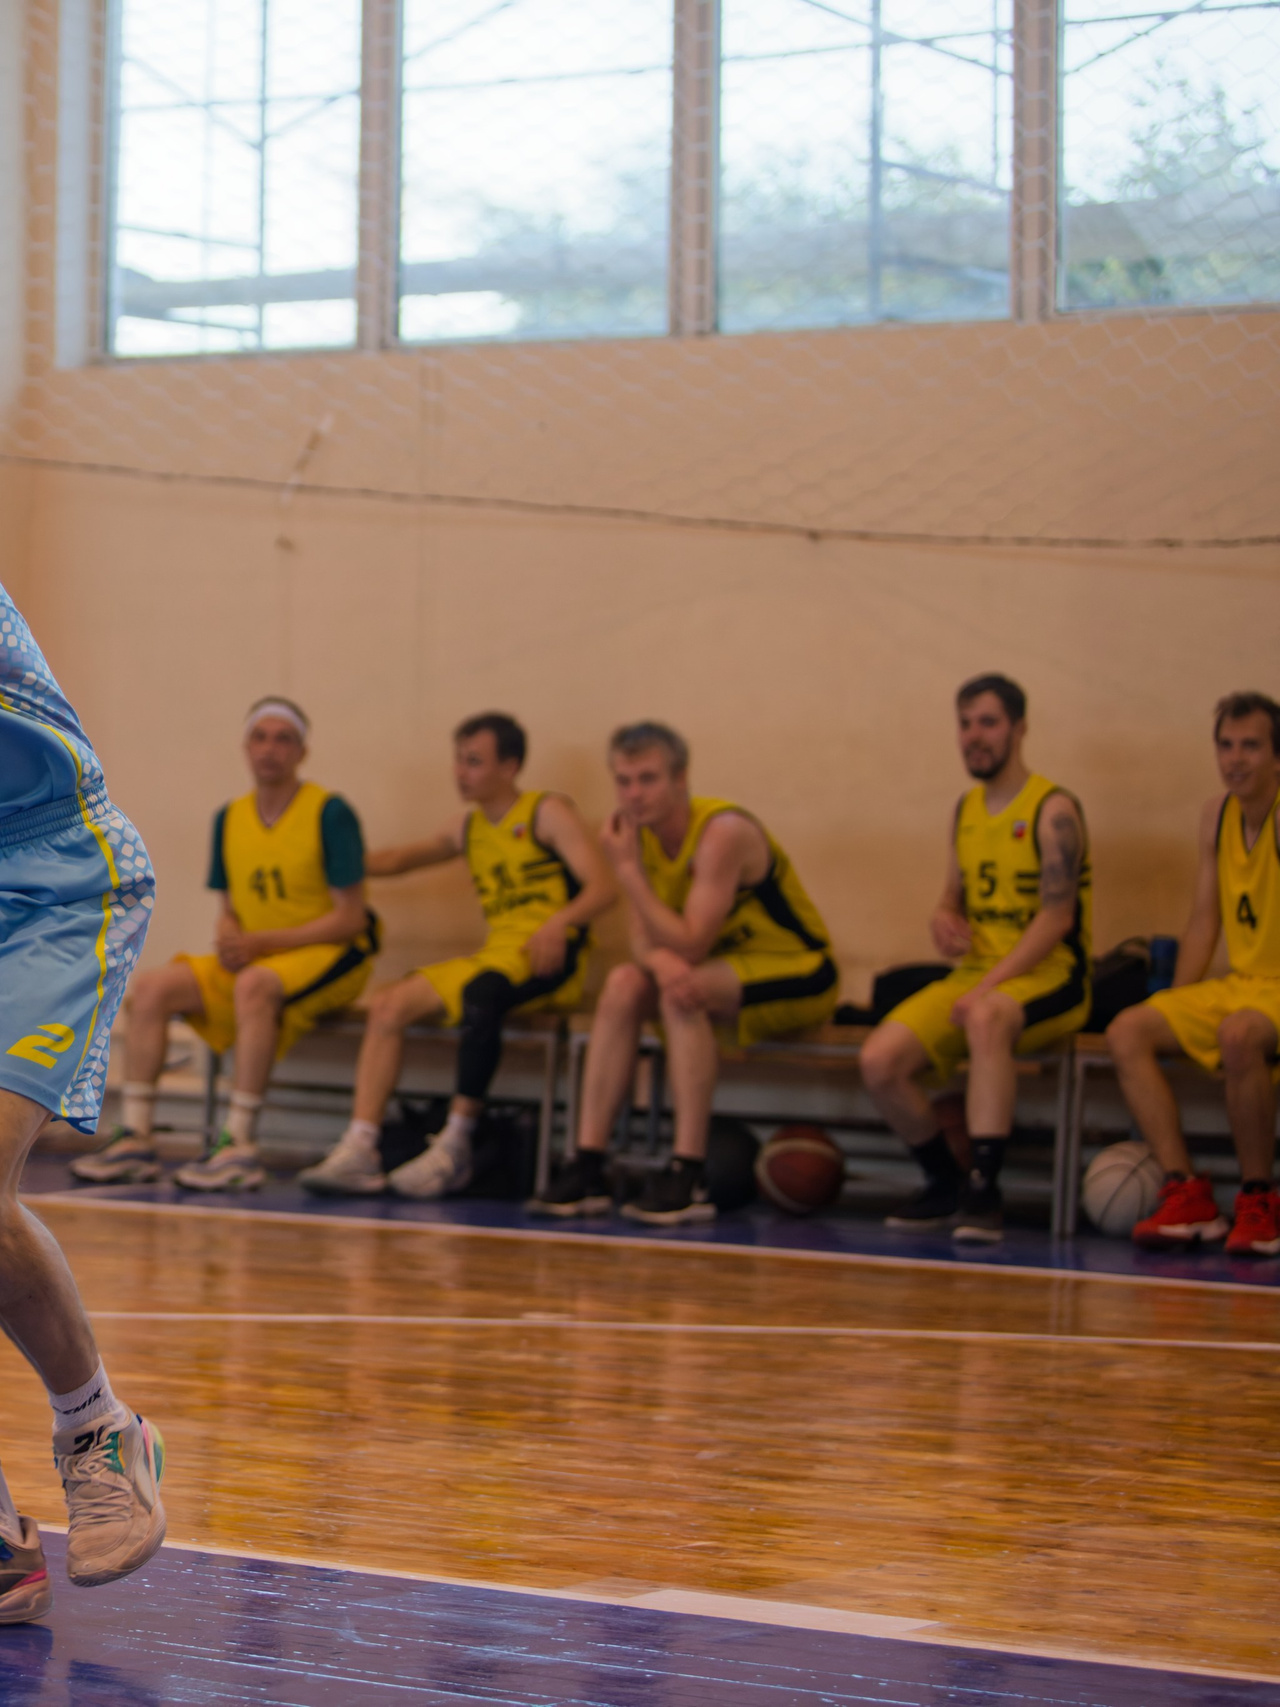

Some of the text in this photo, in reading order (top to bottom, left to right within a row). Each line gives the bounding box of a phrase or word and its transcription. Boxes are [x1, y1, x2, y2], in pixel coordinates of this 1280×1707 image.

[979, 861, 997, 899] 5
[1236, 891, 1258, 931] 4
[5, 1023, 75, 1070] 2
